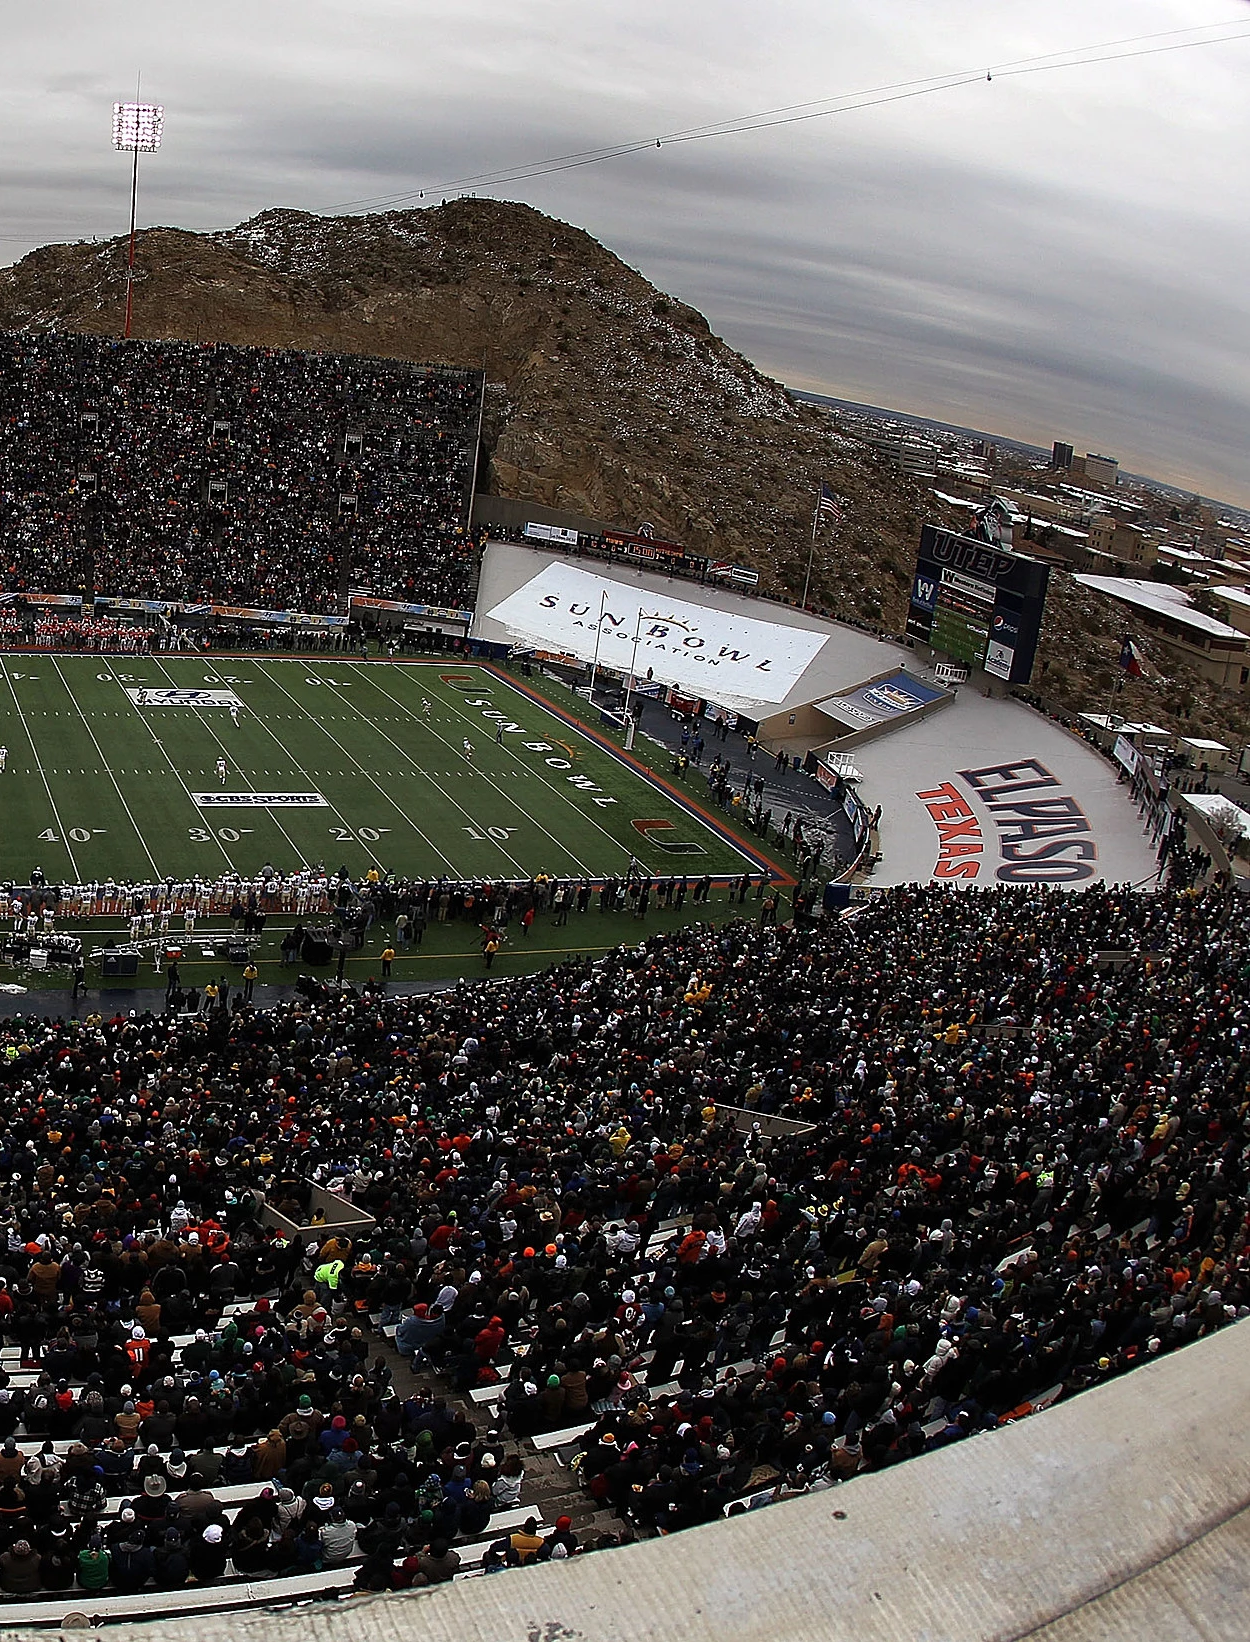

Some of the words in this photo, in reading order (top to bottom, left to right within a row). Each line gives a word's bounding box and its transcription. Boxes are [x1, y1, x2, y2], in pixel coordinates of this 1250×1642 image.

[933, 531, 1018, 580] UTEP
[538, 595, 626, 627] SUN
[646, 624, 773, 672] BOWL
[572, 620, 721, 667] ASSOCIATION
[464, 698, 527, 735] SUN
[521, 740, 618, 808] BOWL
[955, 757, 1062, 803] EL
[37, 828, 91, 843] 40
[187, 827, 242, 843] 30
[328, 827, 381, 842] 20
[461, 825, 511, 841] 10
[914, 781, 983, 880] TEXAS
[984, 795, 1098, 882] PASO
[134, 1347, 143, 1361] 11
